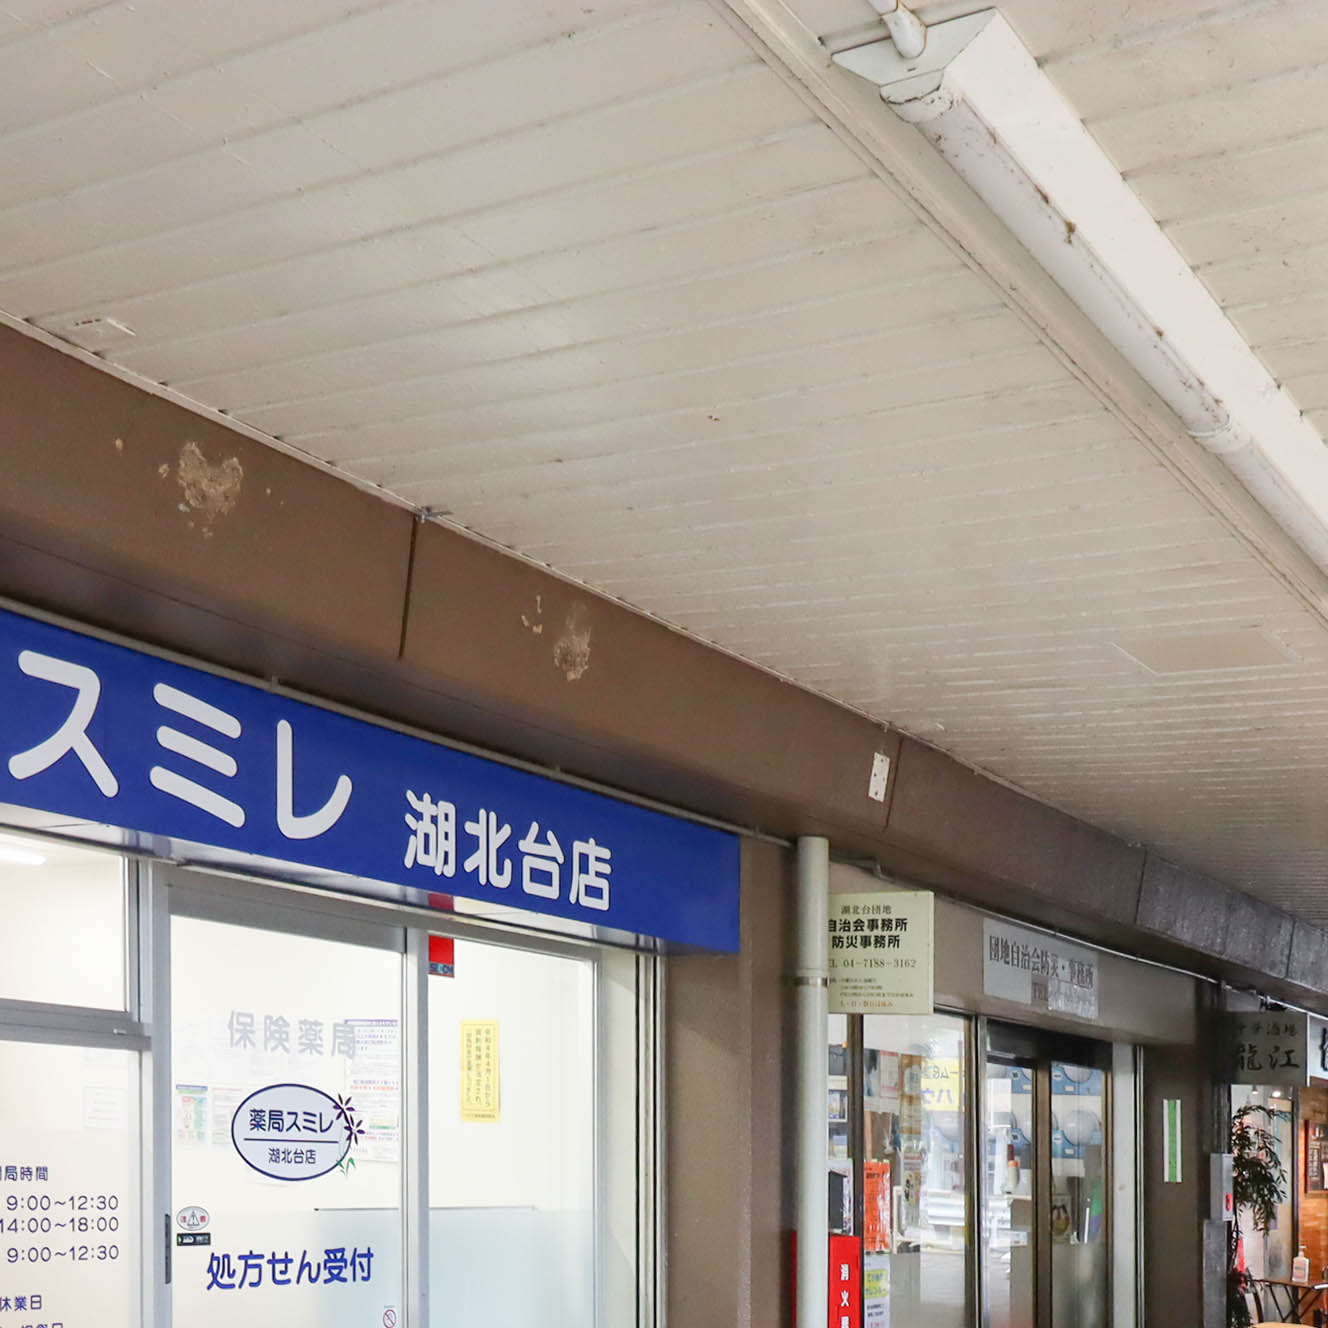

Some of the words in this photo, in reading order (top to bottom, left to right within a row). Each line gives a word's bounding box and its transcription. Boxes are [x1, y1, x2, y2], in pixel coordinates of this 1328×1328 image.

[404, 789, 612, 911] 湖北台店
[828, 918, 908, 932] 自治会事務所
[831, 935, 900, 949] 防災事務所
[228, 1010, 356, 1060] 保険薬局
[249, 1109, 334, 1133] 薬局スミレ
[268, 1148, 317, 1164] 湖北台店
[207, 1247, 374, 1290] 処方せん受付
